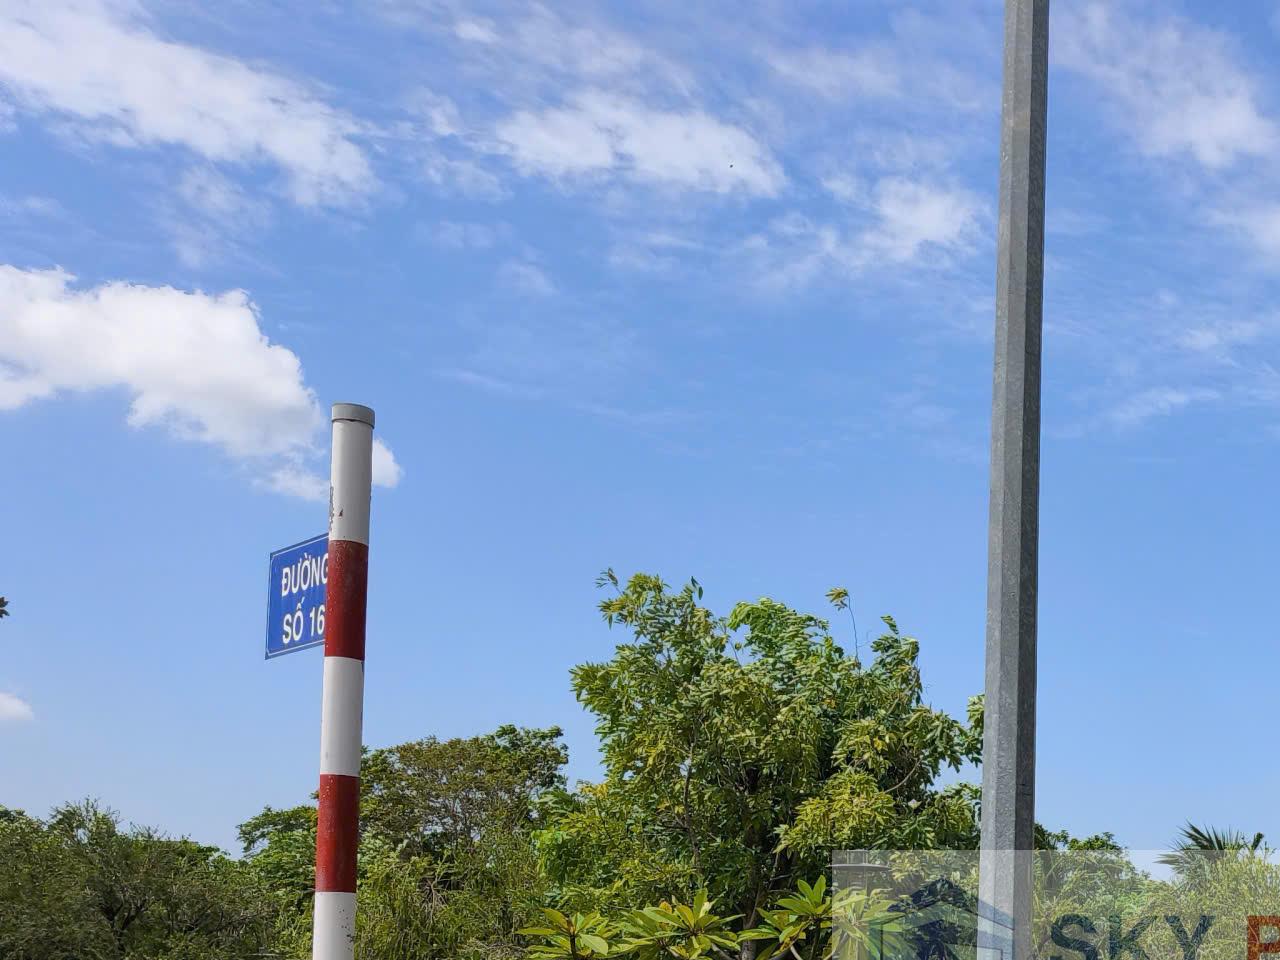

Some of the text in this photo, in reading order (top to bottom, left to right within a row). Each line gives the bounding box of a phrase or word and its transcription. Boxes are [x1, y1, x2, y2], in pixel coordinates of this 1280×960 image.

[281, 552, 329, 597] ĐƯỜNG
[282, 597, 325, 644] SỐ 16
